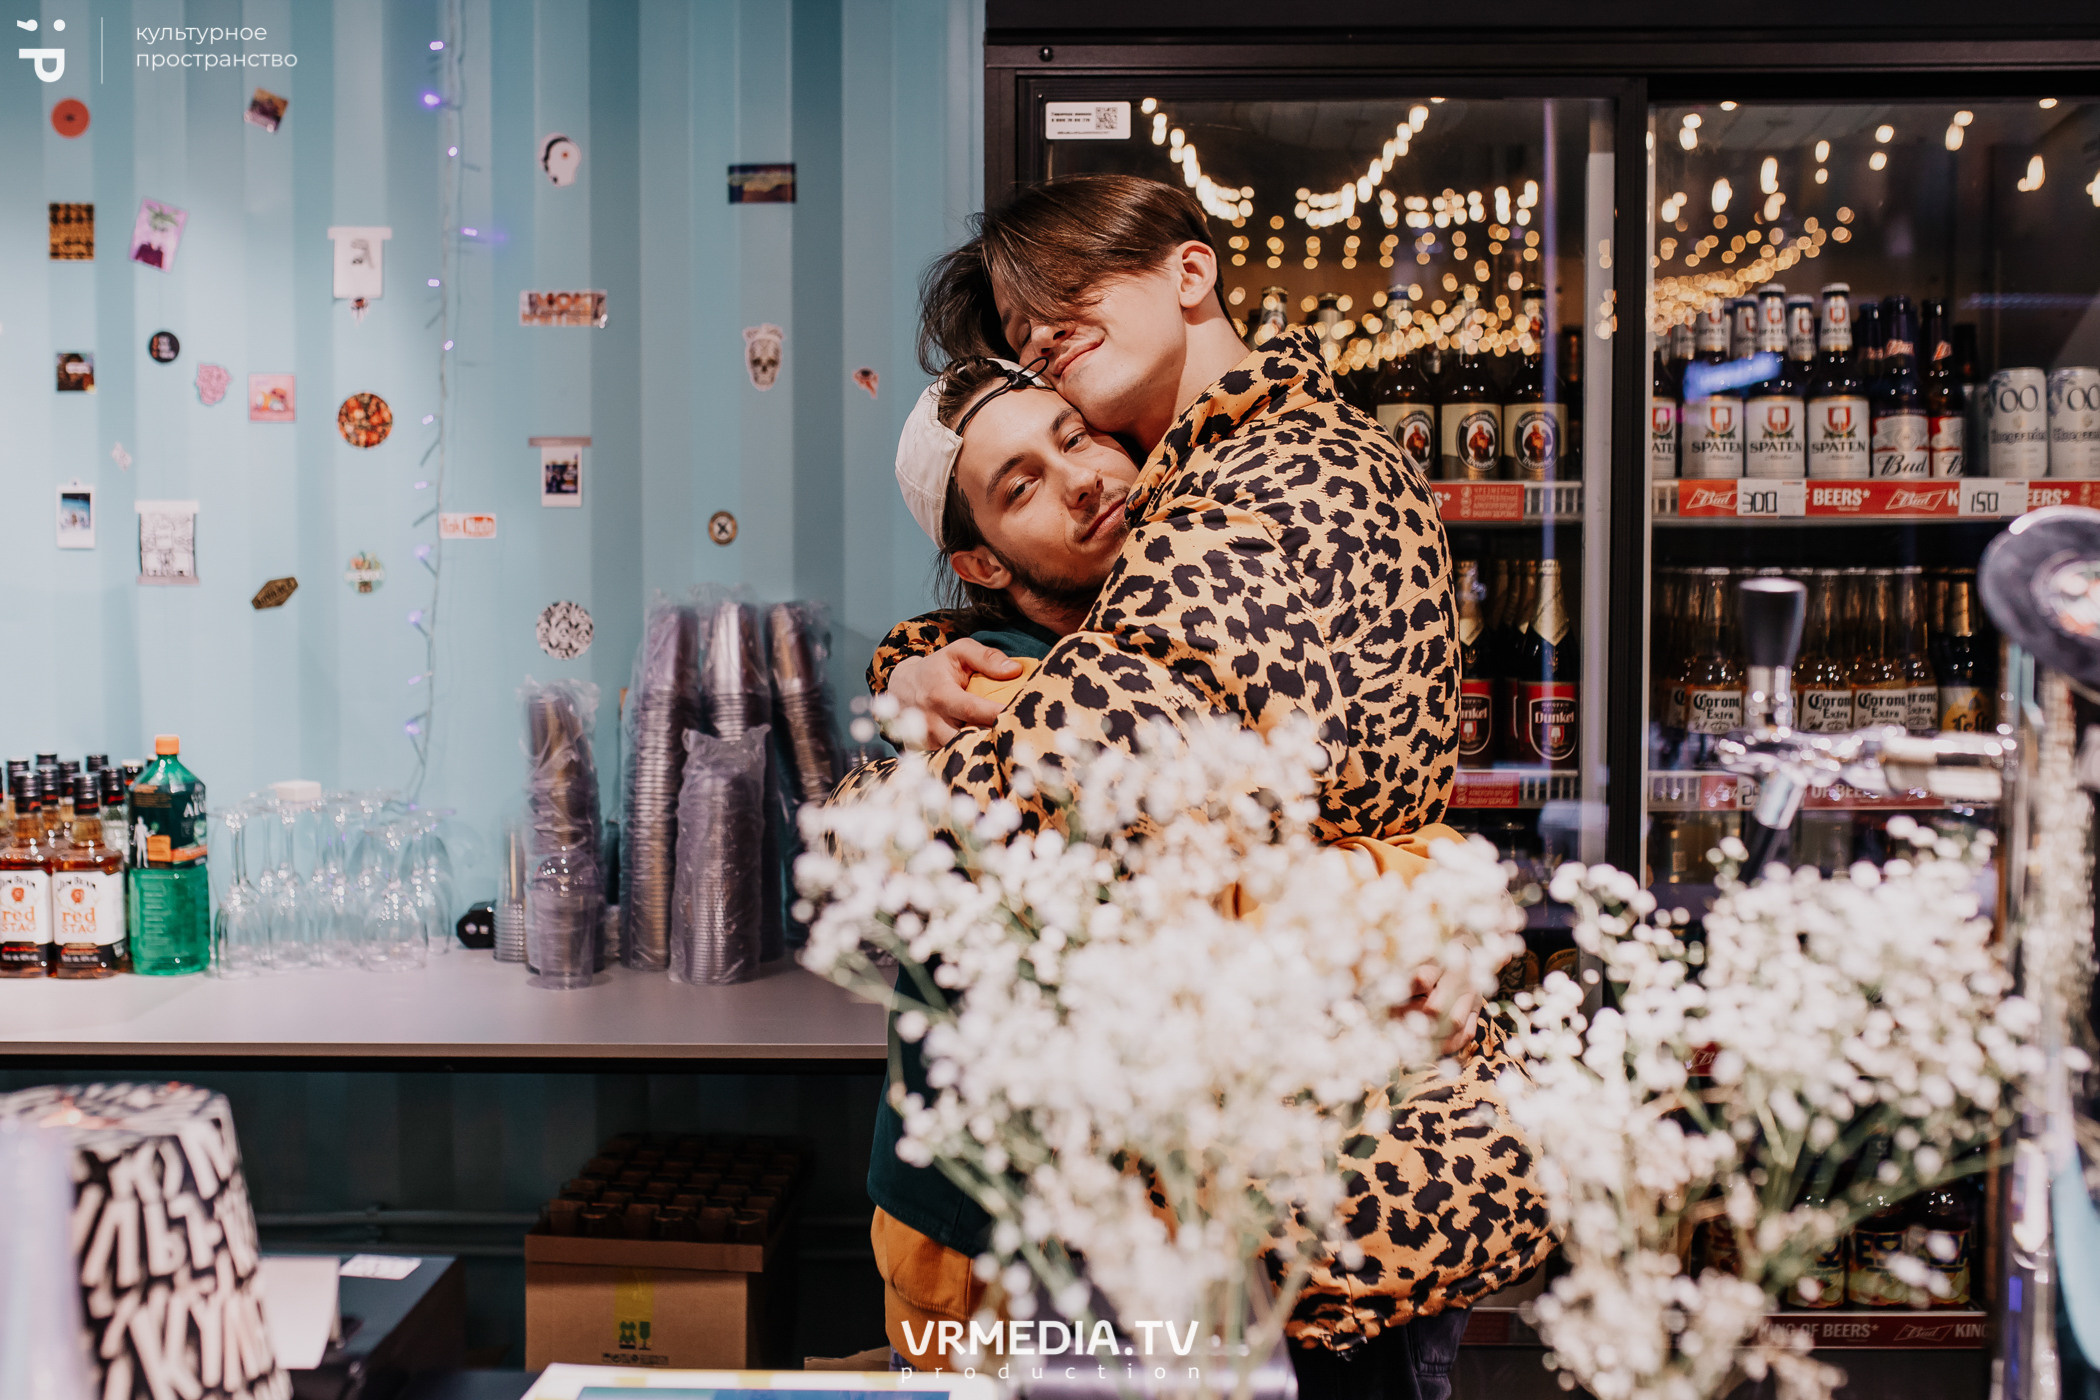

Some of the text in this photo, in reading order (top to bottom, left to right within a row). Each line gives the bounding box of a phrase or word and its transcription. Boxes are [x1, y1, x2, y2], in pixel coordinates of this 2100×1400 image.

[1750, 441, 1802, 454] SPATEN
[1812, 441, 1866, 454] SPATEN
[1878, 455, 1928, 476] Bud
[2028, 488, 2071, 506] EERS
[1808, 693, 1852, 711] Coron
[1460, 707, 1488, 719] unkel
[1534, 711, 1575, 724] Dunkel
[2, 907, 35, 922] red
[62, 908, 96, 922] red
